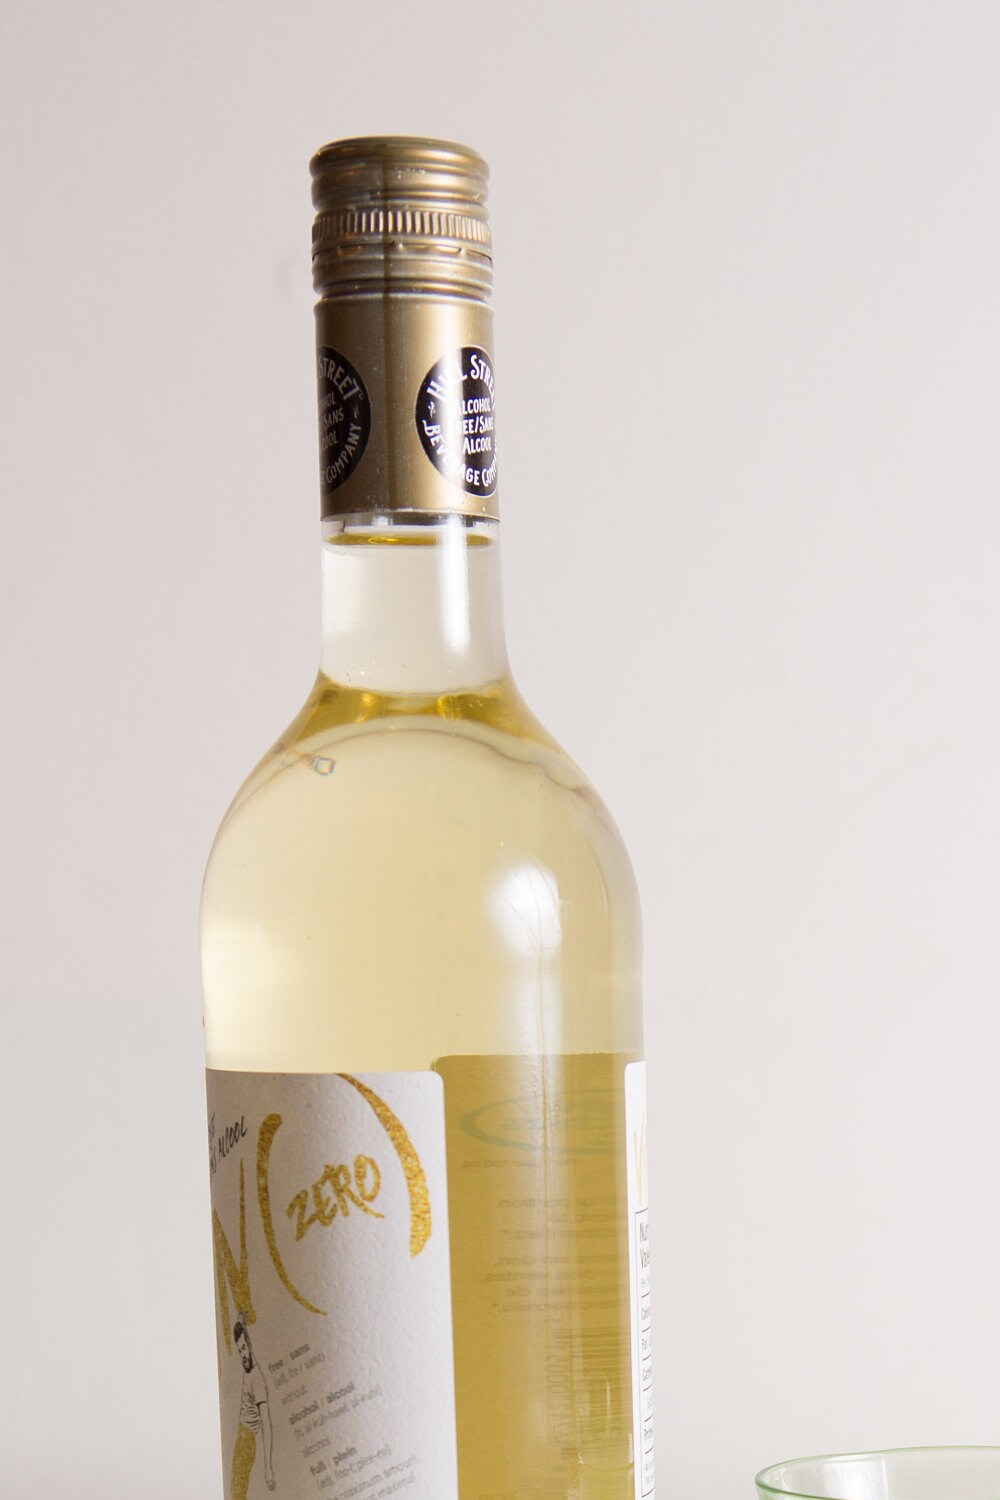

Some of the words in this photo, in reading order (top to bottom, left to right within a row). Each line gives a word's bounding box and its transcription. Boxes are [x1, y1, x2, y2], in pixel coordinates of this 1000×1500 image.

[326, 423, 362, 484] COMPANY
[289, 1343, 311, 1360] sans
[289, 1400, 319, 1425] alcohol
[326, 1381, 355, 1404] alcool
